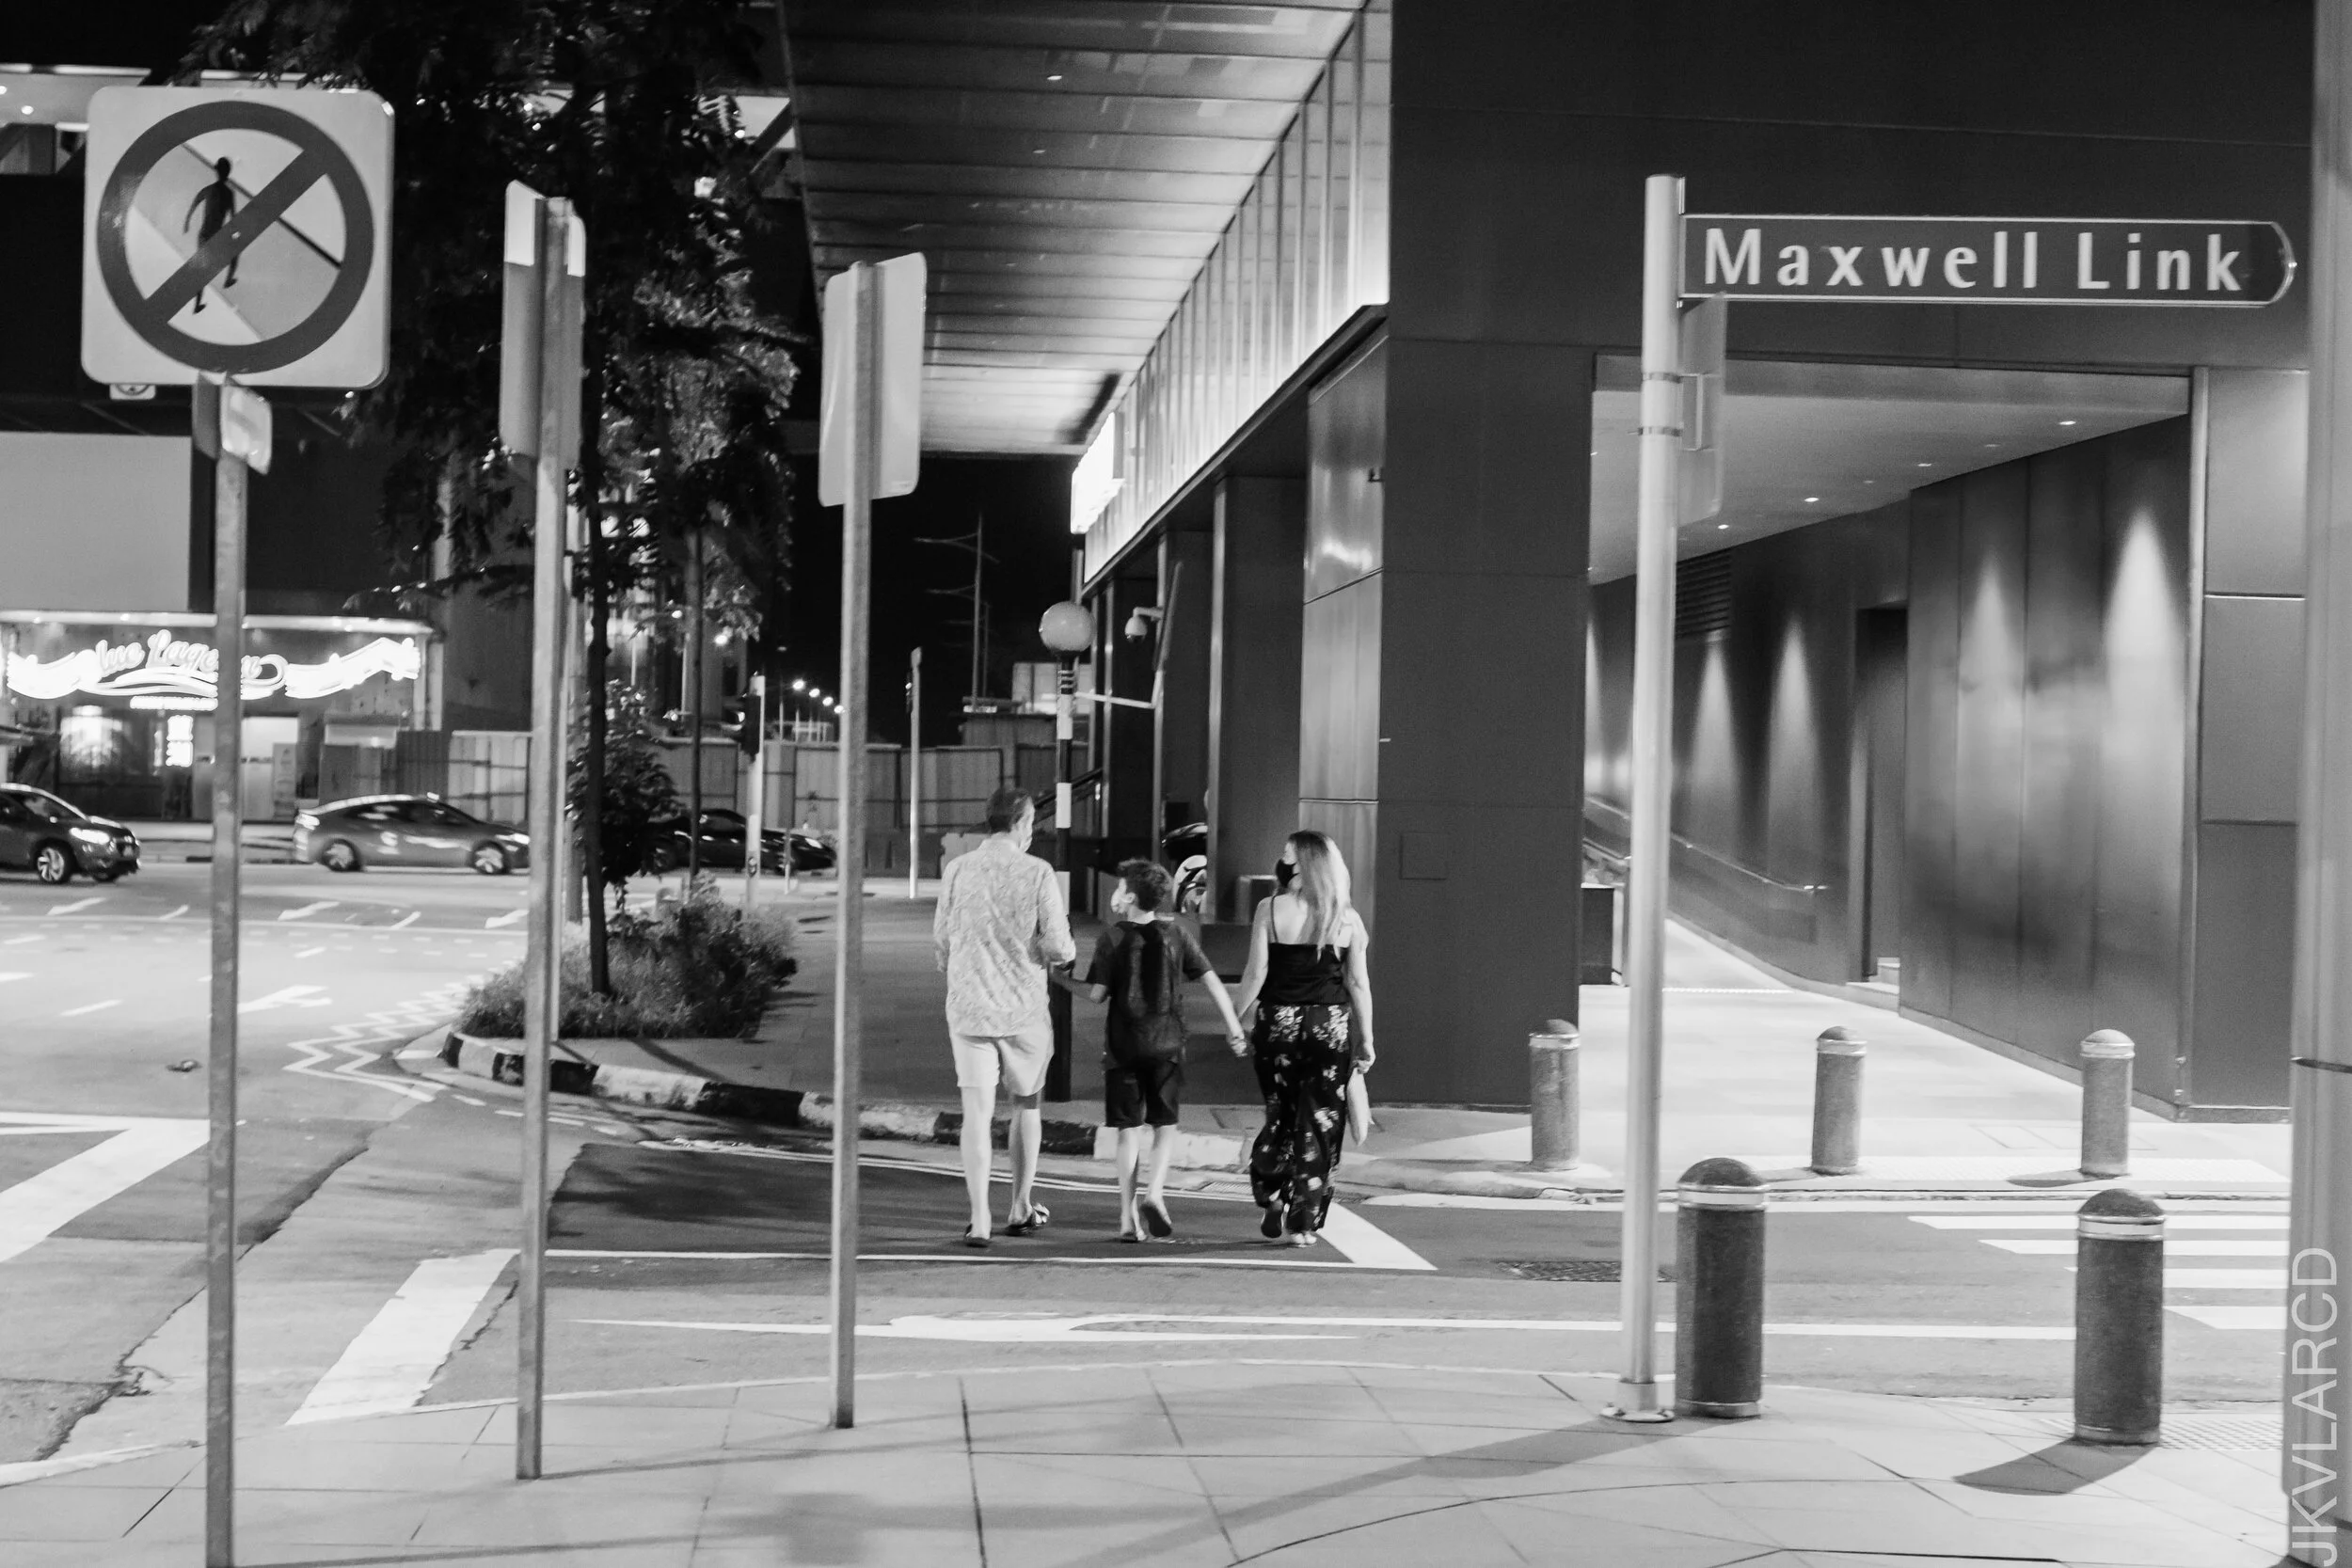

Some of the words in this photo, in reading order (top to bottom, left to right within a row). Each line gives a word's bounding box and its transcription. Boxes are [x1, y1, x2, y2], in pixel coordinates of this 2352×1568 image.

[1705, 228, 2039, 289] Maxwell
[2077, 232, 2243, 292] Link
[75, 639, 146, 681] lue
[146, 628, 265, 680] Lagon
